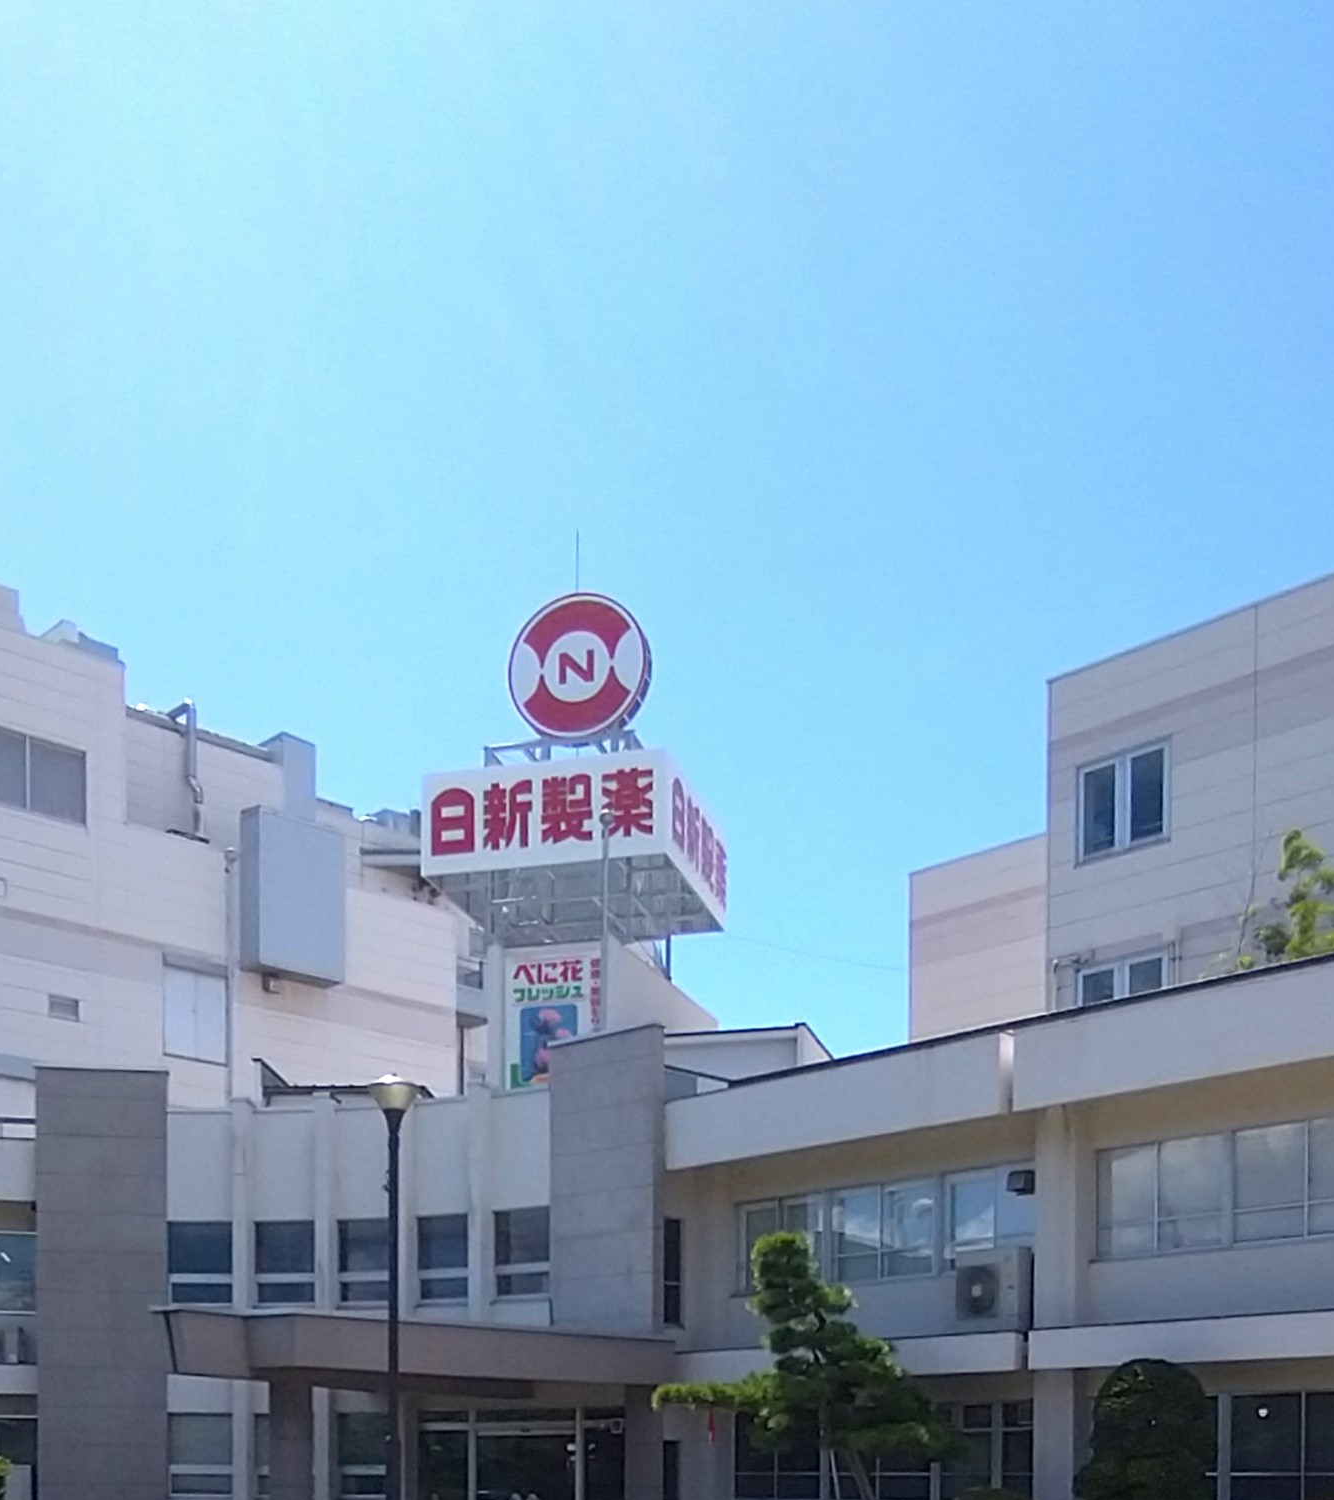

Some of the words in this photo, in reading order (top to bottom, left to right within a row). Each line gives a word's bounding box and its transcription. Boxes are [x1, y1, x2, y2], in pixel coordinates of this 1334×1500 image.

[559, 649, 594, 685] N
[431, 768, 653, 856] 日新製薬
[513, 959, 584, 985] べに花
[513, 985, 584, 1003] フレッシュ
